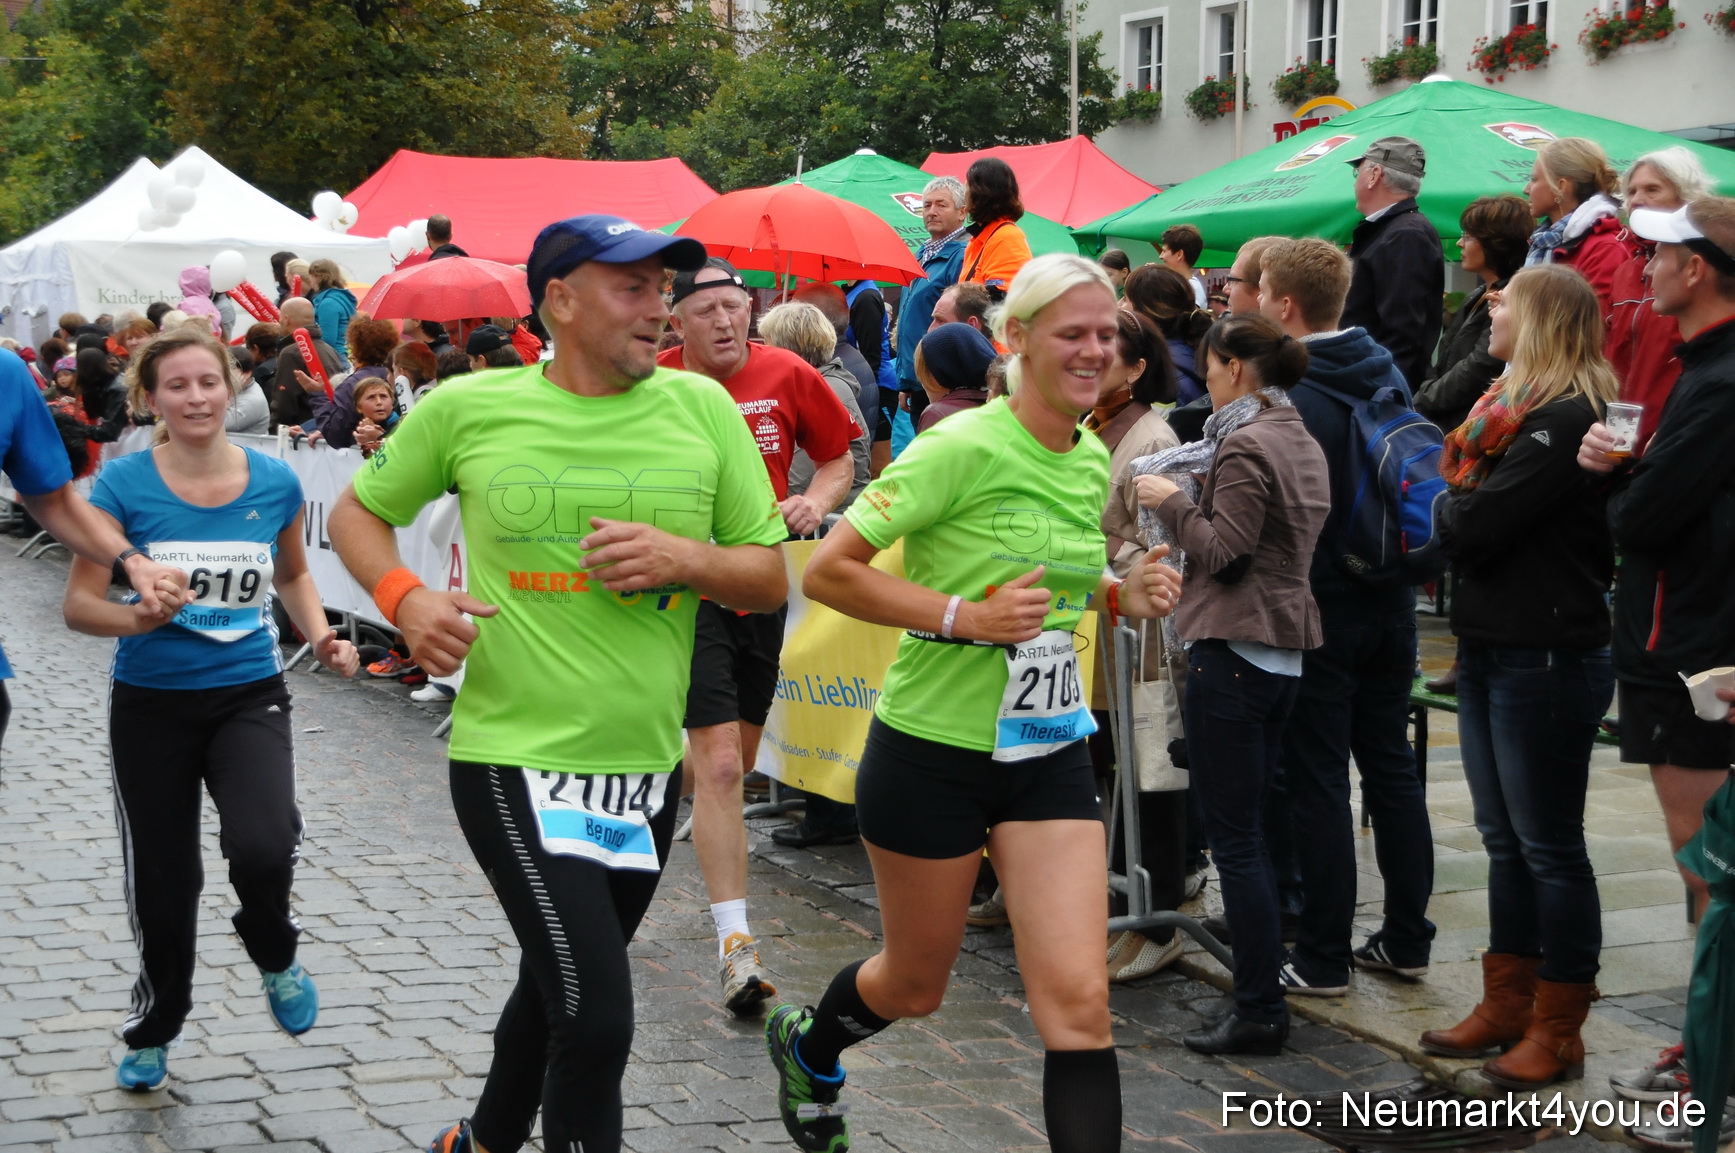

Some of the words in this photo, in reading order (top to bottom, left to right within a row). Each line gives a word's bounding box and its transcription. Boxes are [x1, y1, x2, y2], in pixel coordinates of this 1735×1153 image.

[98, 288, 155, 305] Kinder
[736, 399, 779, 410] EUMARKTER
[740, 406, 772, 415] ADTLAUF
[537, 535, 555, 543] und
[152, 552, 194, 562] PARTL
[196, 553, 253, 563] Neumarkt
[188, 567, 262, 604] 619
[508, 570, 590, 593] MERZ
[506, 583, 572, 604] Reisen
[179, 609, 231, 627] Sandra
[1017, 645, 1048, 660] ARTL
[1012, 656, 1080, 711] 2103
[804, 674, 882, 712] Lieblin
[585, 817, 627, 848] Benno
